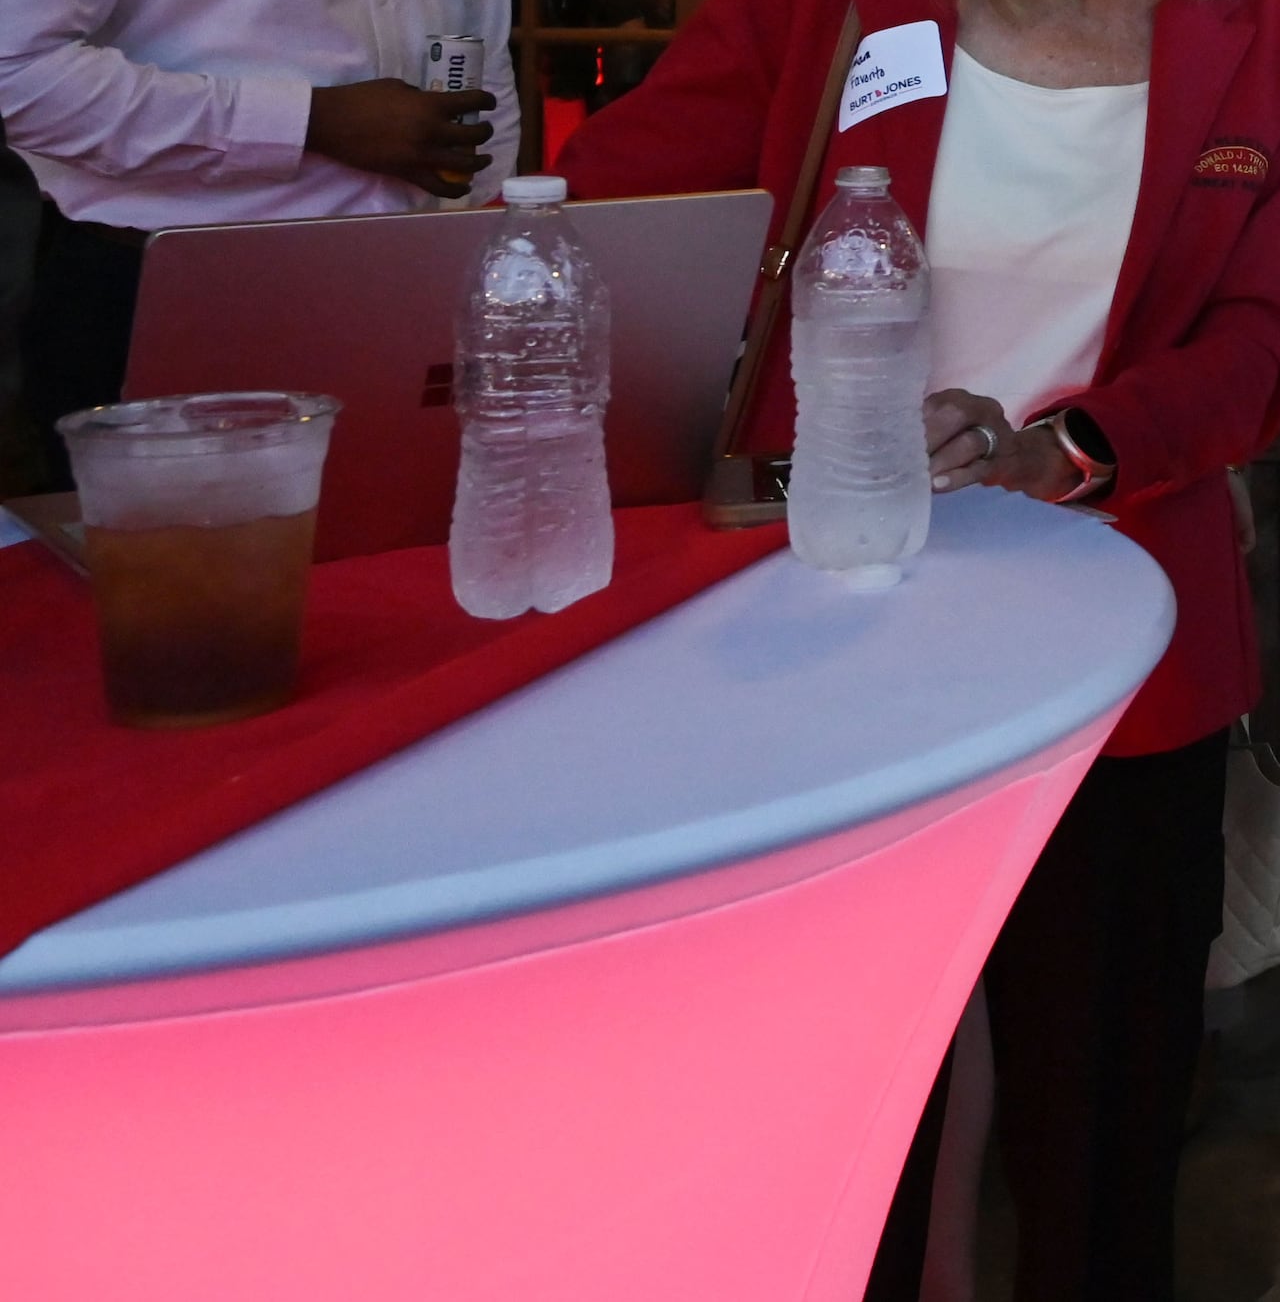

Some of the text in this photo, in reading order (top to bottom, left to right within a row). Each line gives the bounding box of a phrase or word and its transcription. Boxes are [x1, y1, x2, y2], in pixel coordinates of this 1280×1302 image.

[849, 75, 923, 112] BURT JONES
[1194, 150, 1235, 173] DONALD
